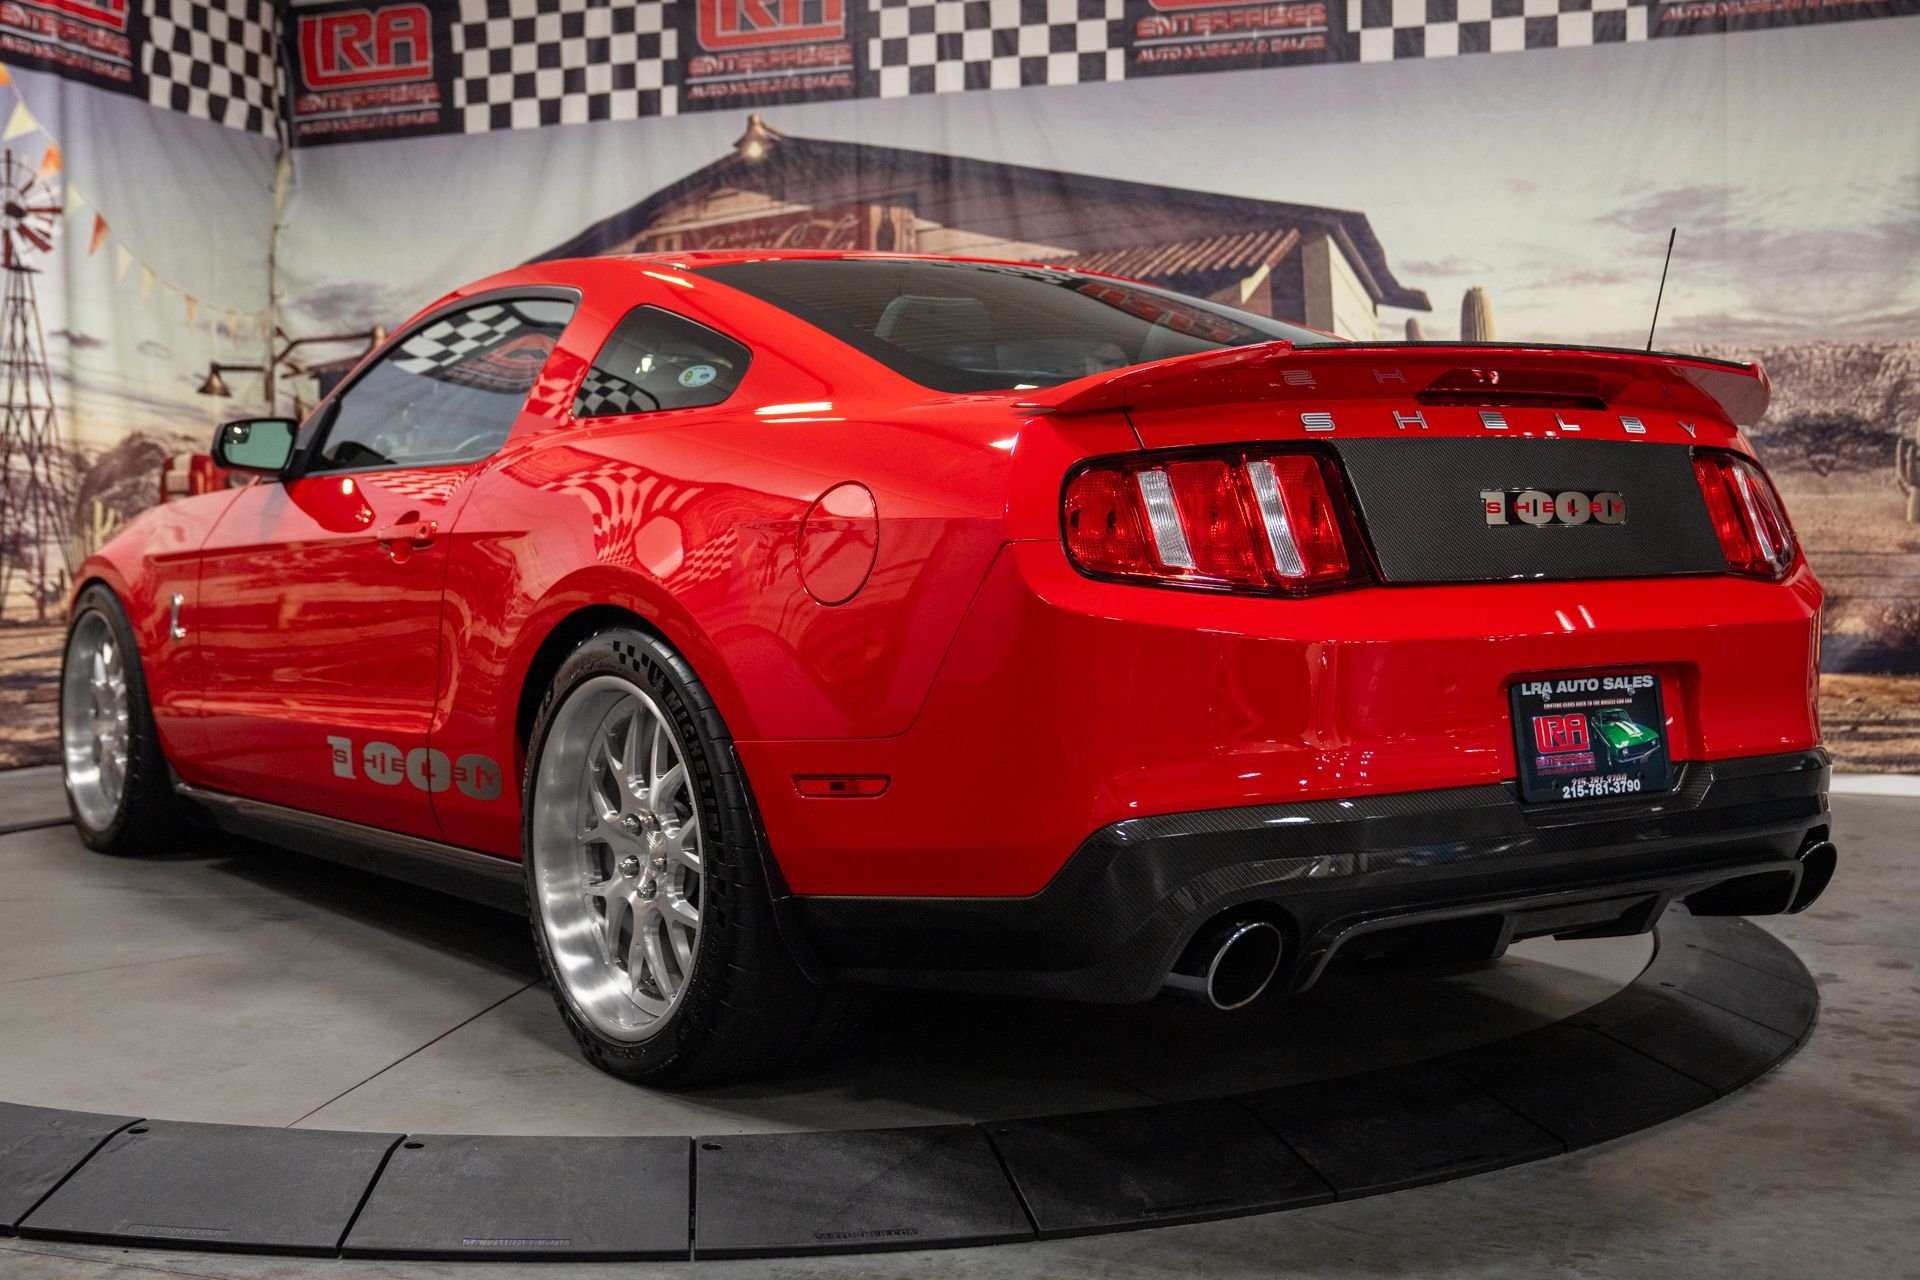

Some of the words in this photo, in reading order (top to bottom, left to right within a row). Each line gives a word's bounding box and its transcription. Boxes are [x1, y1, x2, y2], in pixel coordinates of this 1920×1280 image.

[1136, 3, 1327, 39] ENTERPRISES
[1300, 409, 1697, 439] SHELBY
[1480, 490, 1626, 525] 1000
[1487, 501, 1623, 514] SHELBY
[1521, 681, 1553, 696] LRA
[1556, 678, 1599, 693] AUTO
[1603, 675, 1653, 690] SALES
[327, 735, 502, 800] 1000
[334, 749, 498, 786] SHELBY
[667, 689, 721, 833] MICHELIN
[1562, 779, 1641, 799] 215-781-3790
